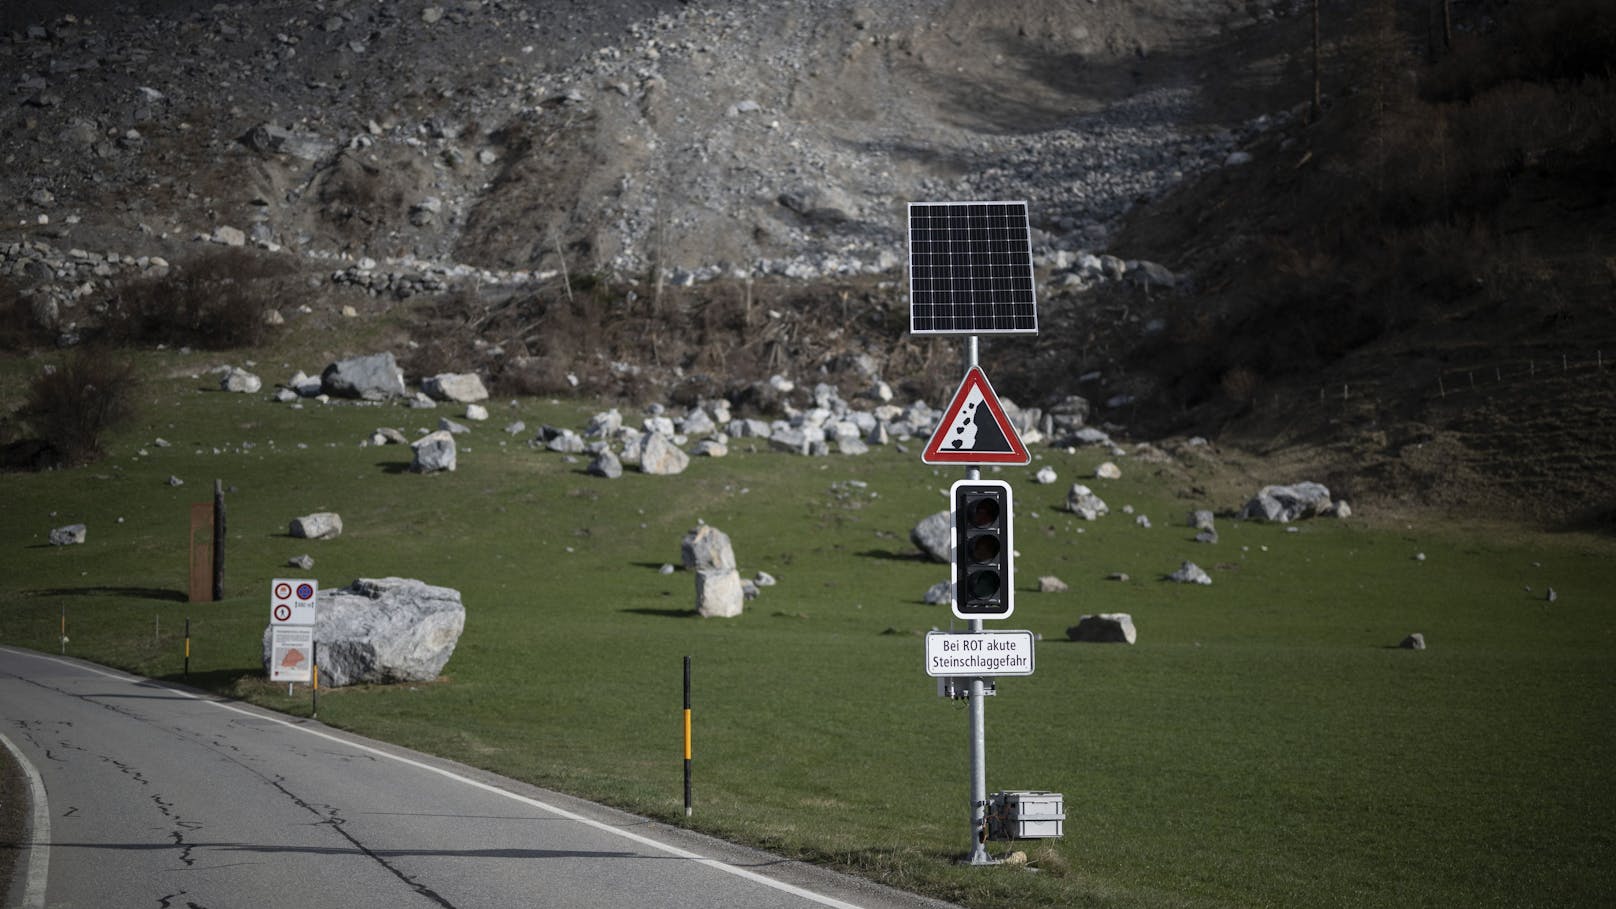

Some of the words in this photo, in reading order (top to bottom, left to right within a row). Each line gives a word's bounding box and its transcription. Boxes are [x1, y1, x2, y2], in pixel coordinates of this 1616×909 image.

[943, 640, 960, 652] Bei
[963, 640, 983, 651] ROT
[987, 639, 1016, 651] akute
[933, 655, 1027, 669] Steinschlaggefahr
